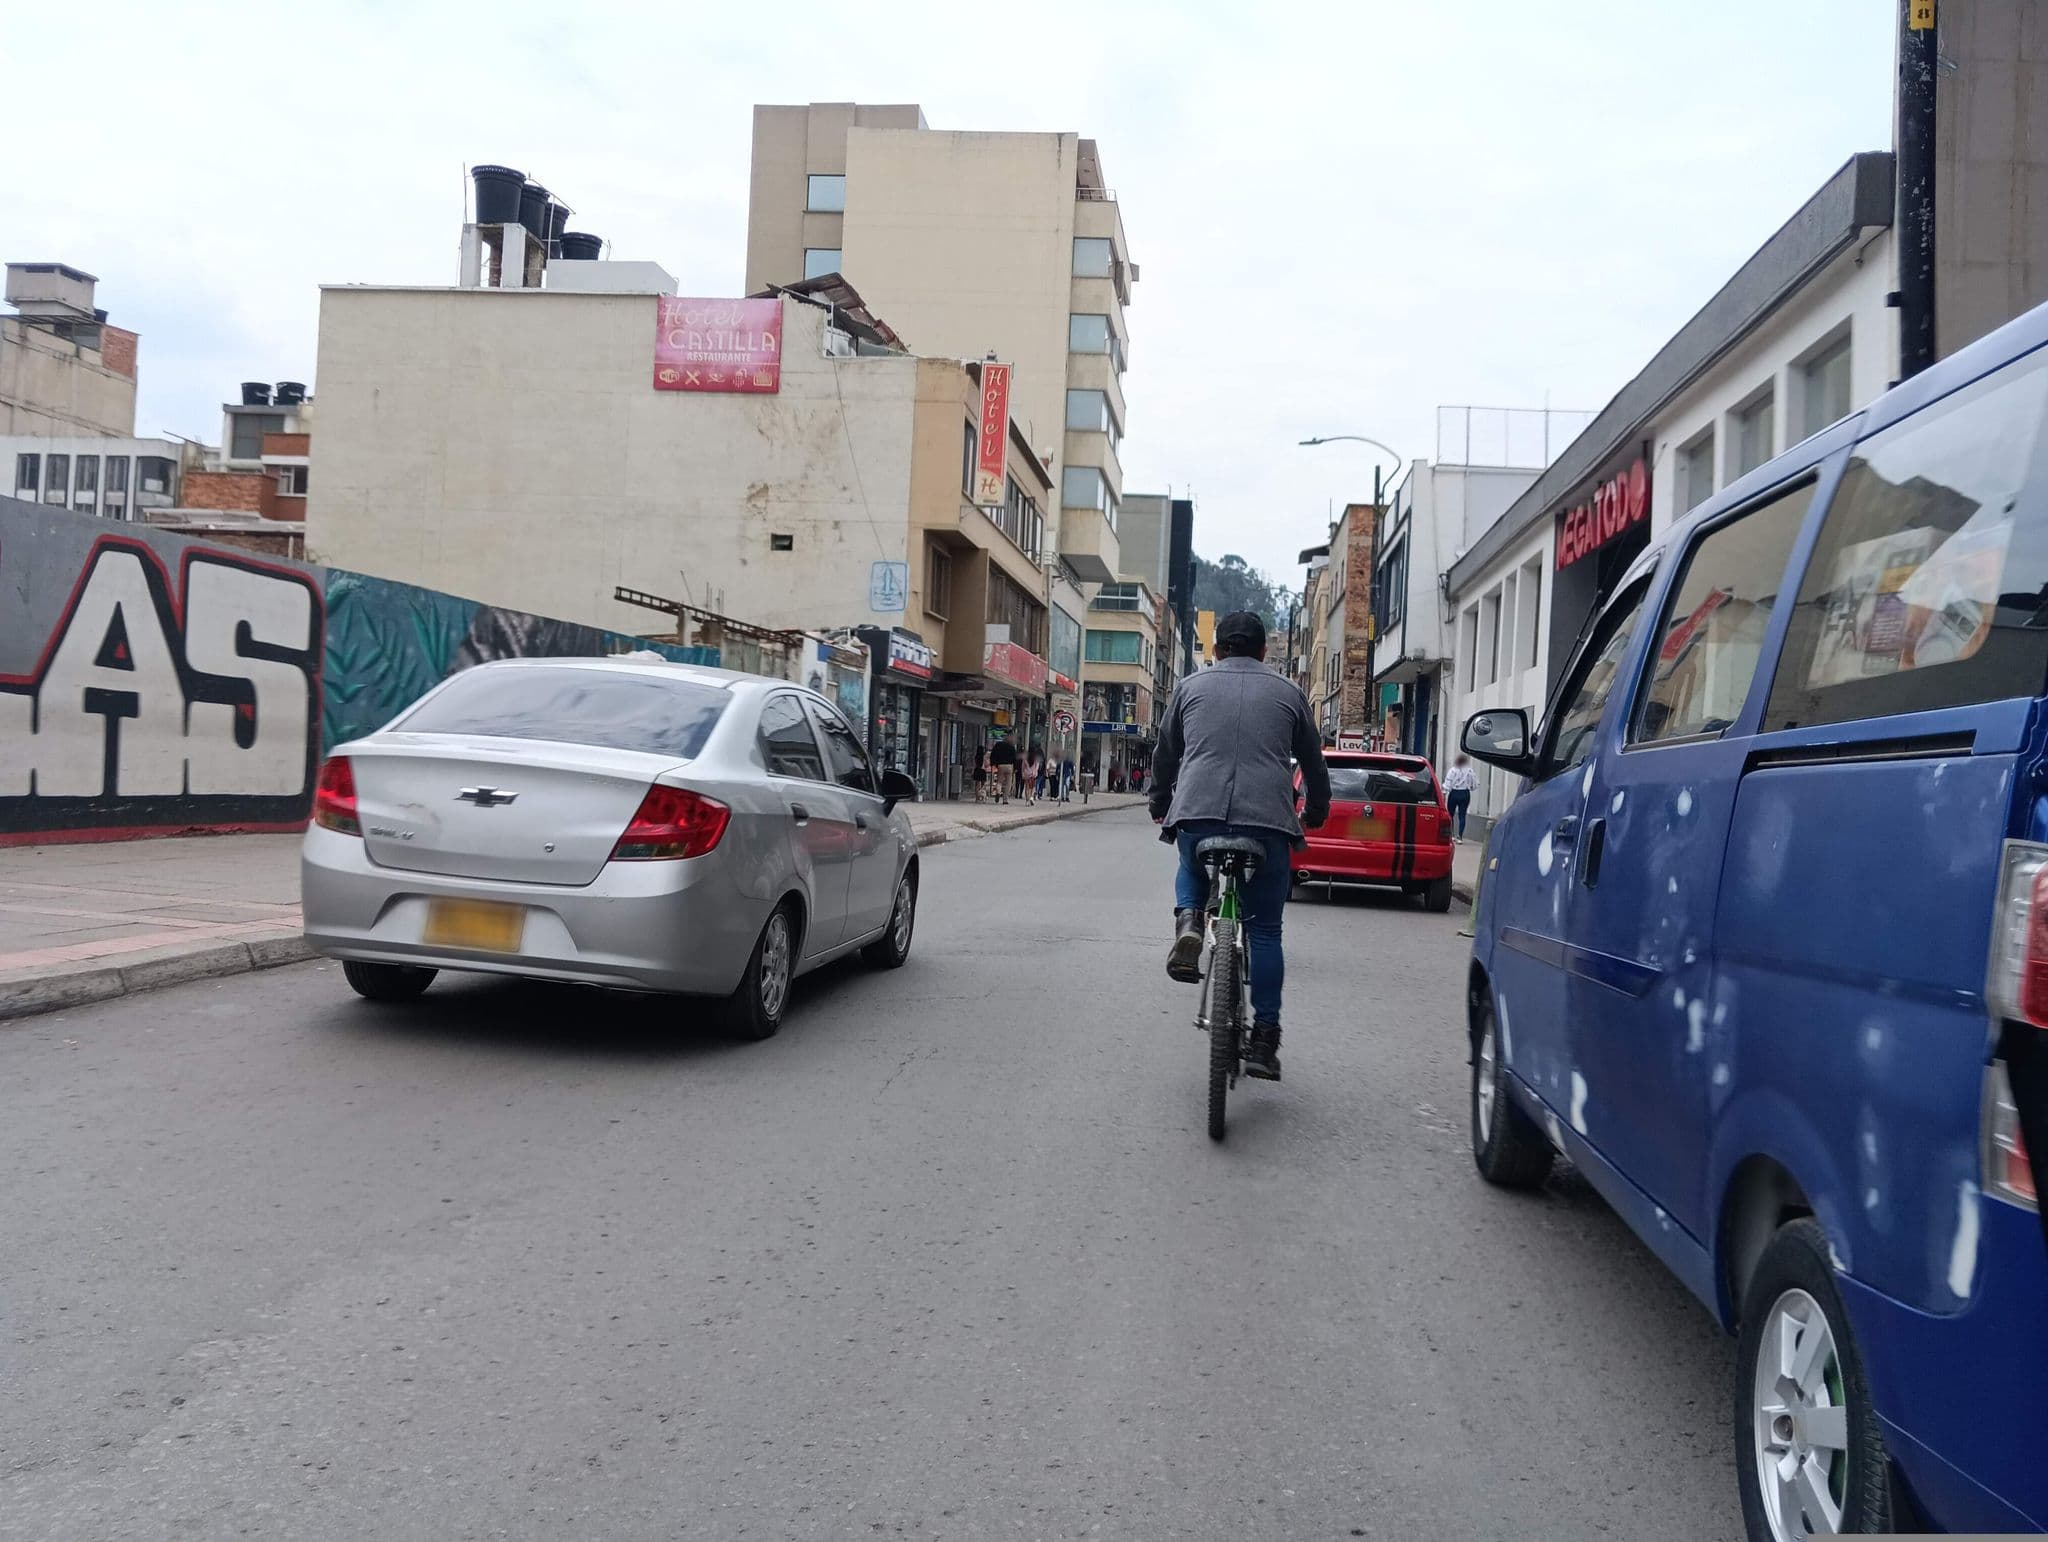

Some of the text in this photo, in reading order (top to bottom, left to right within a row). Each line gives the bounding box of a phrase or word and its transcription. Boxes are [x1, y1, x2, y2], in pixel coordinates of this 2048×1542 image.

[663, 303, 745, 327] Hotel
[668, 328, 776, 353] CASTILLA
[687, 351, 752, 362] RESTAURANTE
[985, 369, 1003, 457] Hotel
